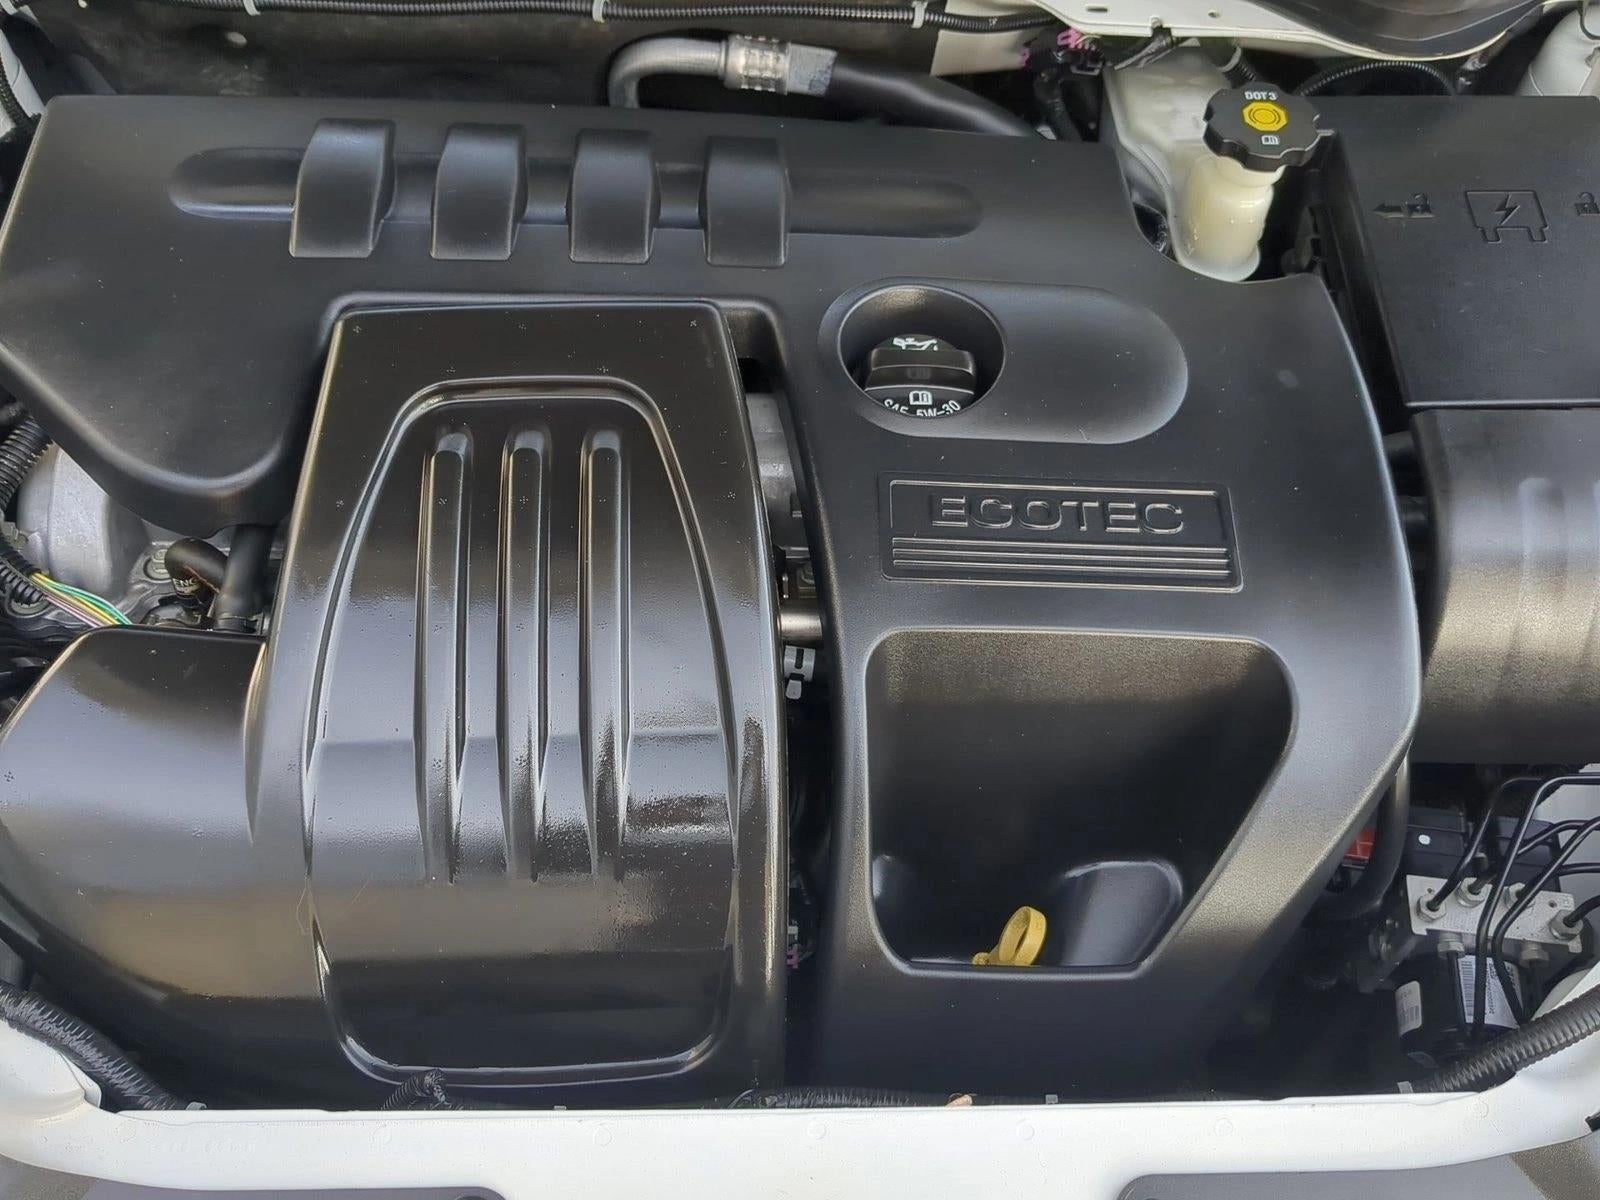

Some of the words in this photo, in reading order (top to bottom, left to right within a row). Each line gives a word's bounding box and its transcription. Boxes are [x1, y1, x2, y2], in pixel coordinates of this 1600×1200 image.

[1244, 91, 1267, 100] DOT
[1268, 91, 1278, 101] 3
[916, 400, 961, 417] 5W-30
[932, 495, 1184, 535] ECOTEC
